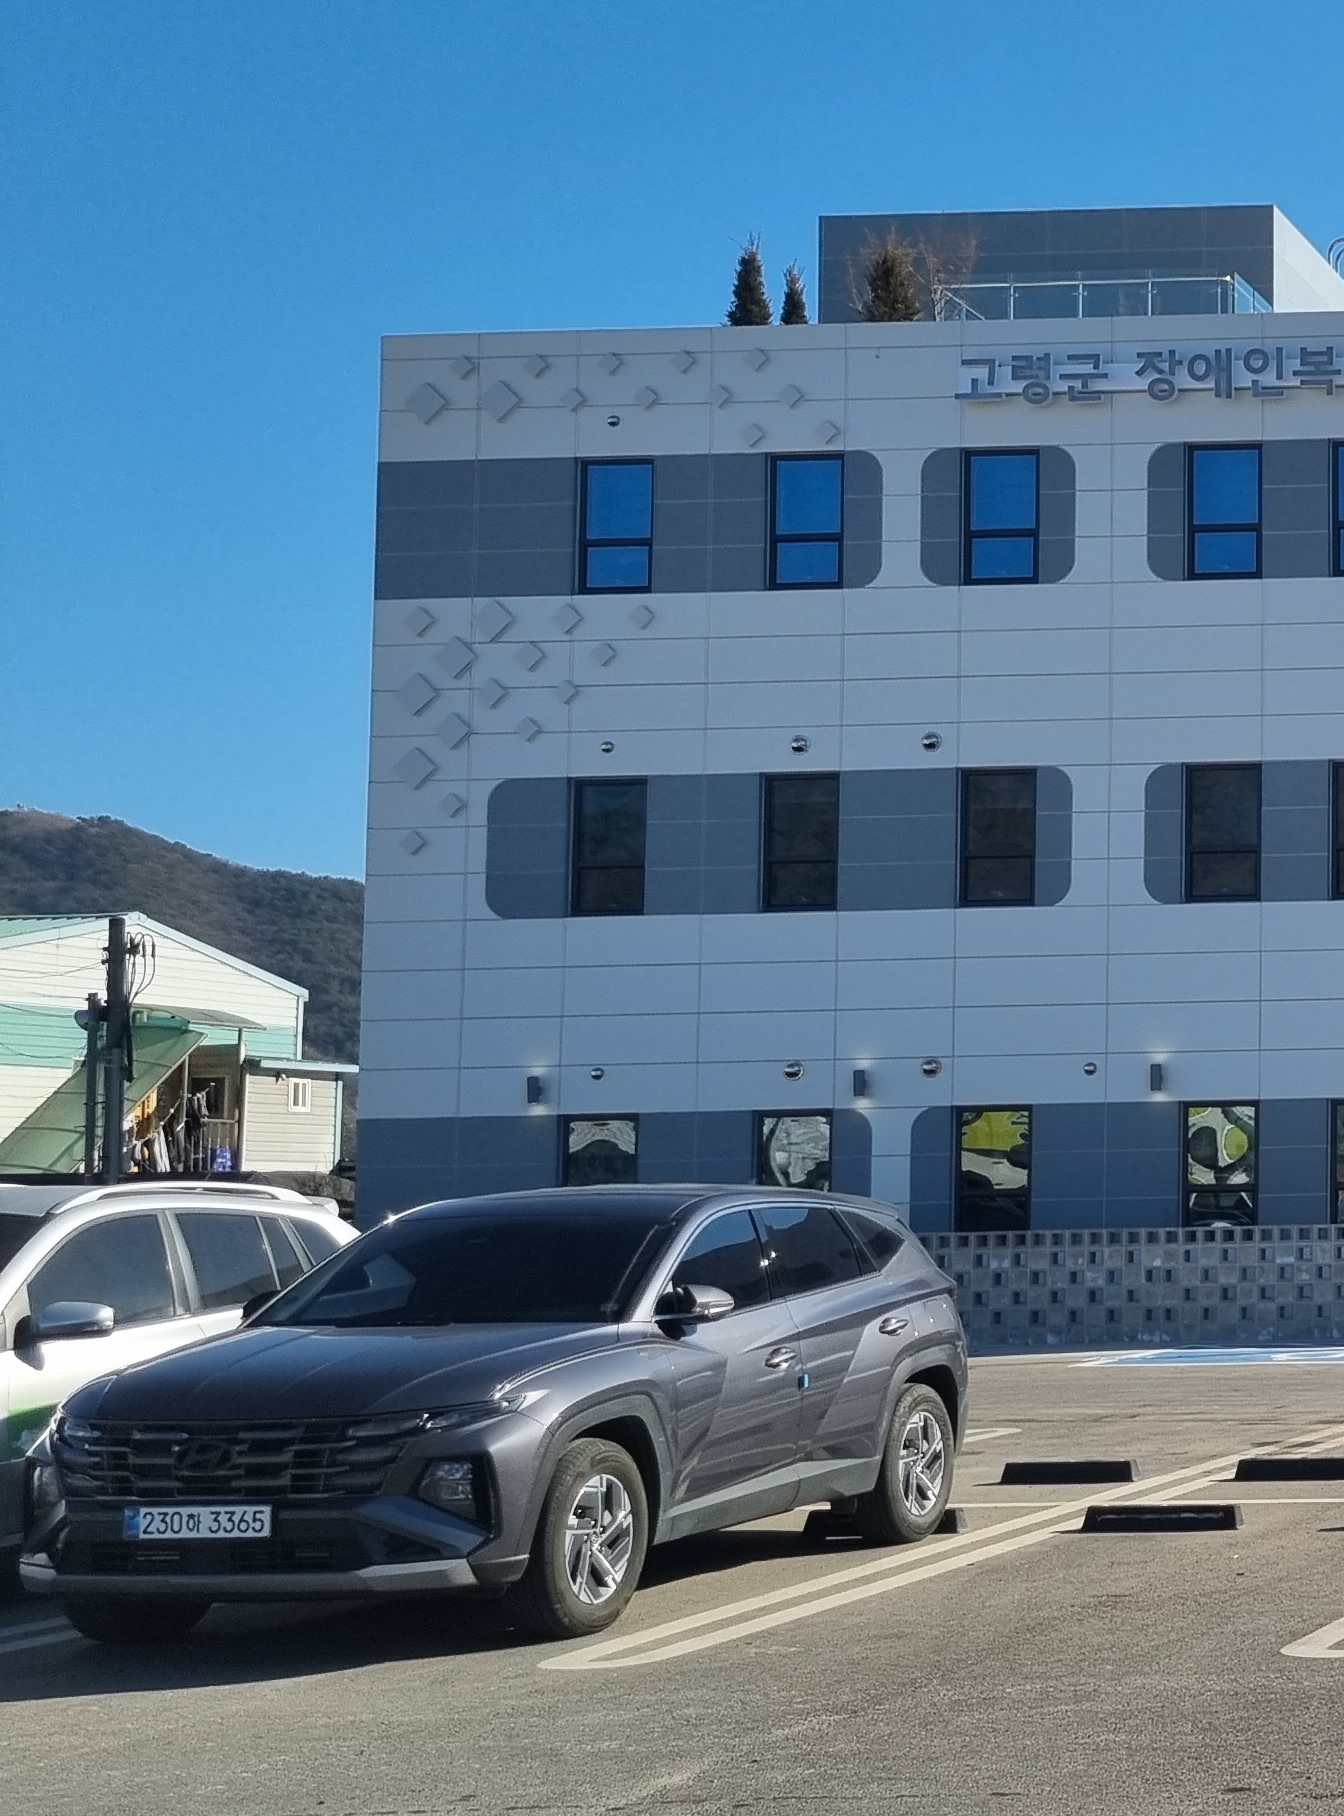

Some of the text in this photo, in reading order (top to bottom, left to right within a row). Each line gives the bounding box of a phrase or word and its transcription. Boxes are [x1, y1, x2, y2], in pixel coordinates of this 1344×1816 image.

[954, 352, 1109, 404] 고령군
[142, 1510, 265, 1534] 230하 3365
